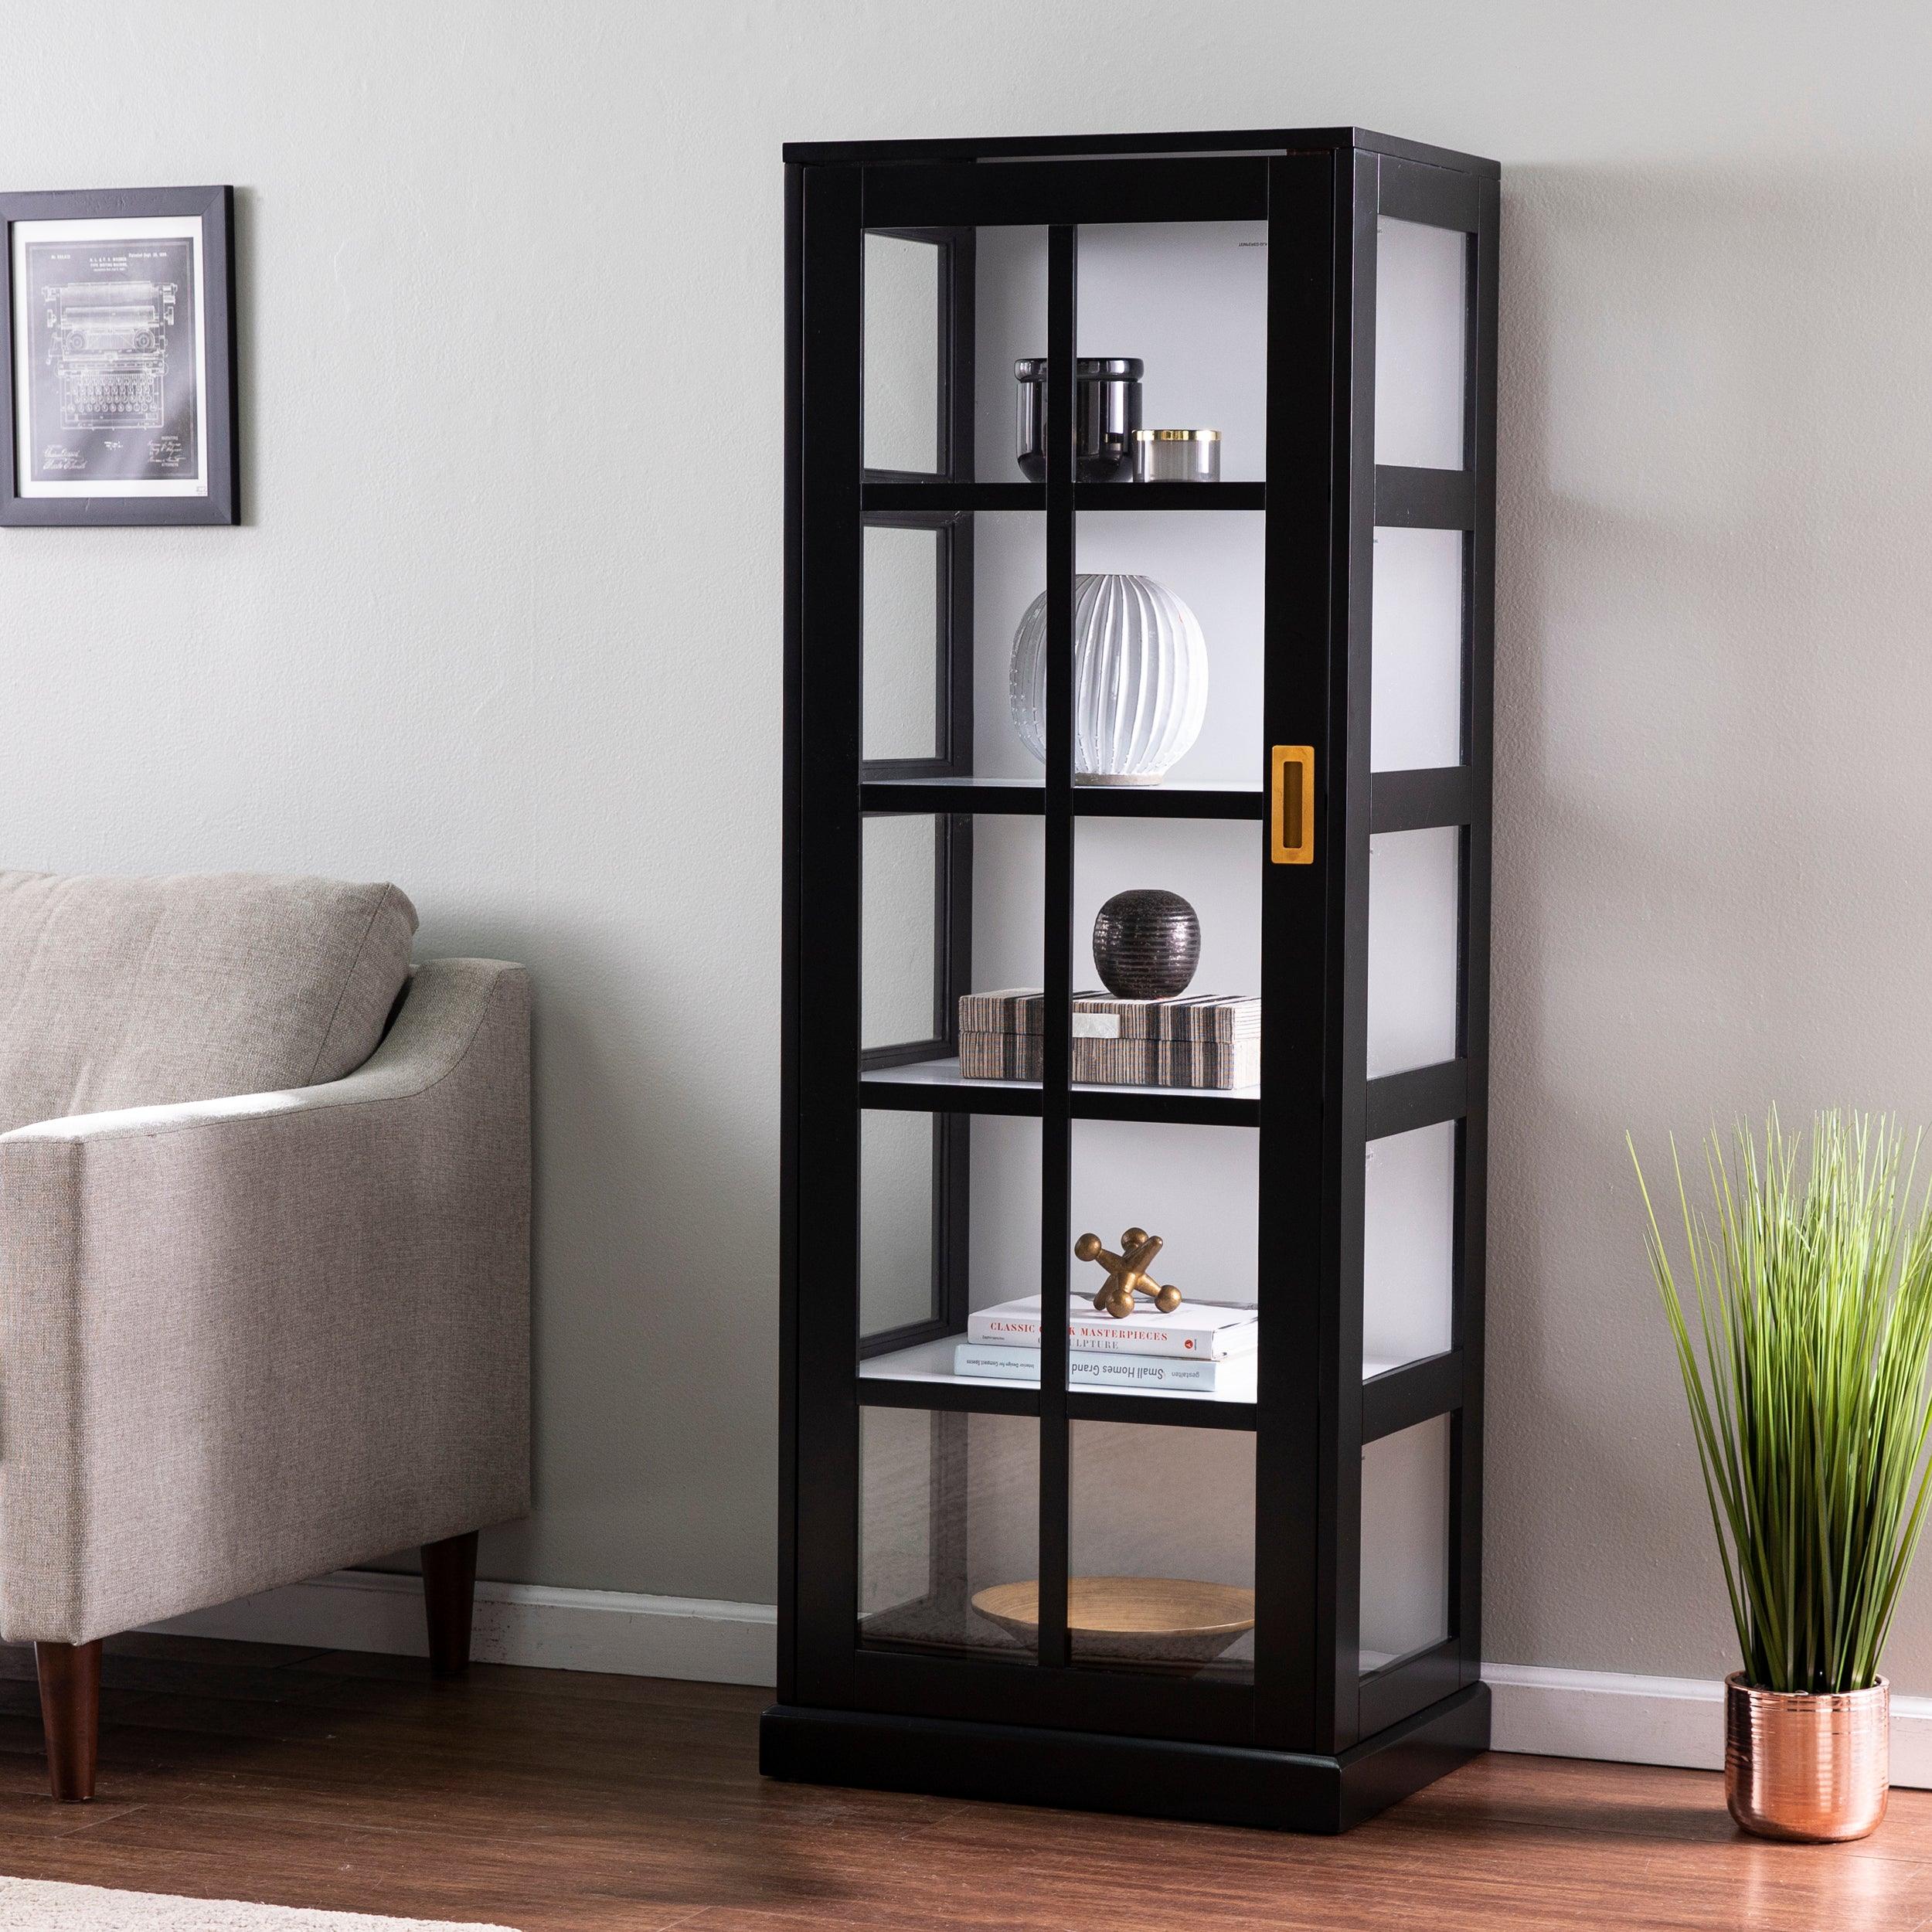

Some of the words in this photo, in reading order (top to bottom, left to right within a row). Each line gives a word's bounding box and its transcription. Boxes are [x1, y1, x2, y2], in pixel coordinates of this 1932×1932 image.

[989, 1322, 1035, 1333] CLASSIC
[1080, 1328, 1168, 1342] MASTERPIECES
[1071, 1363, 1100, 1376] Grand
[1102, 1365, 1135, 1378] Homes
[1137, 1367, 1164, 1379] Small
